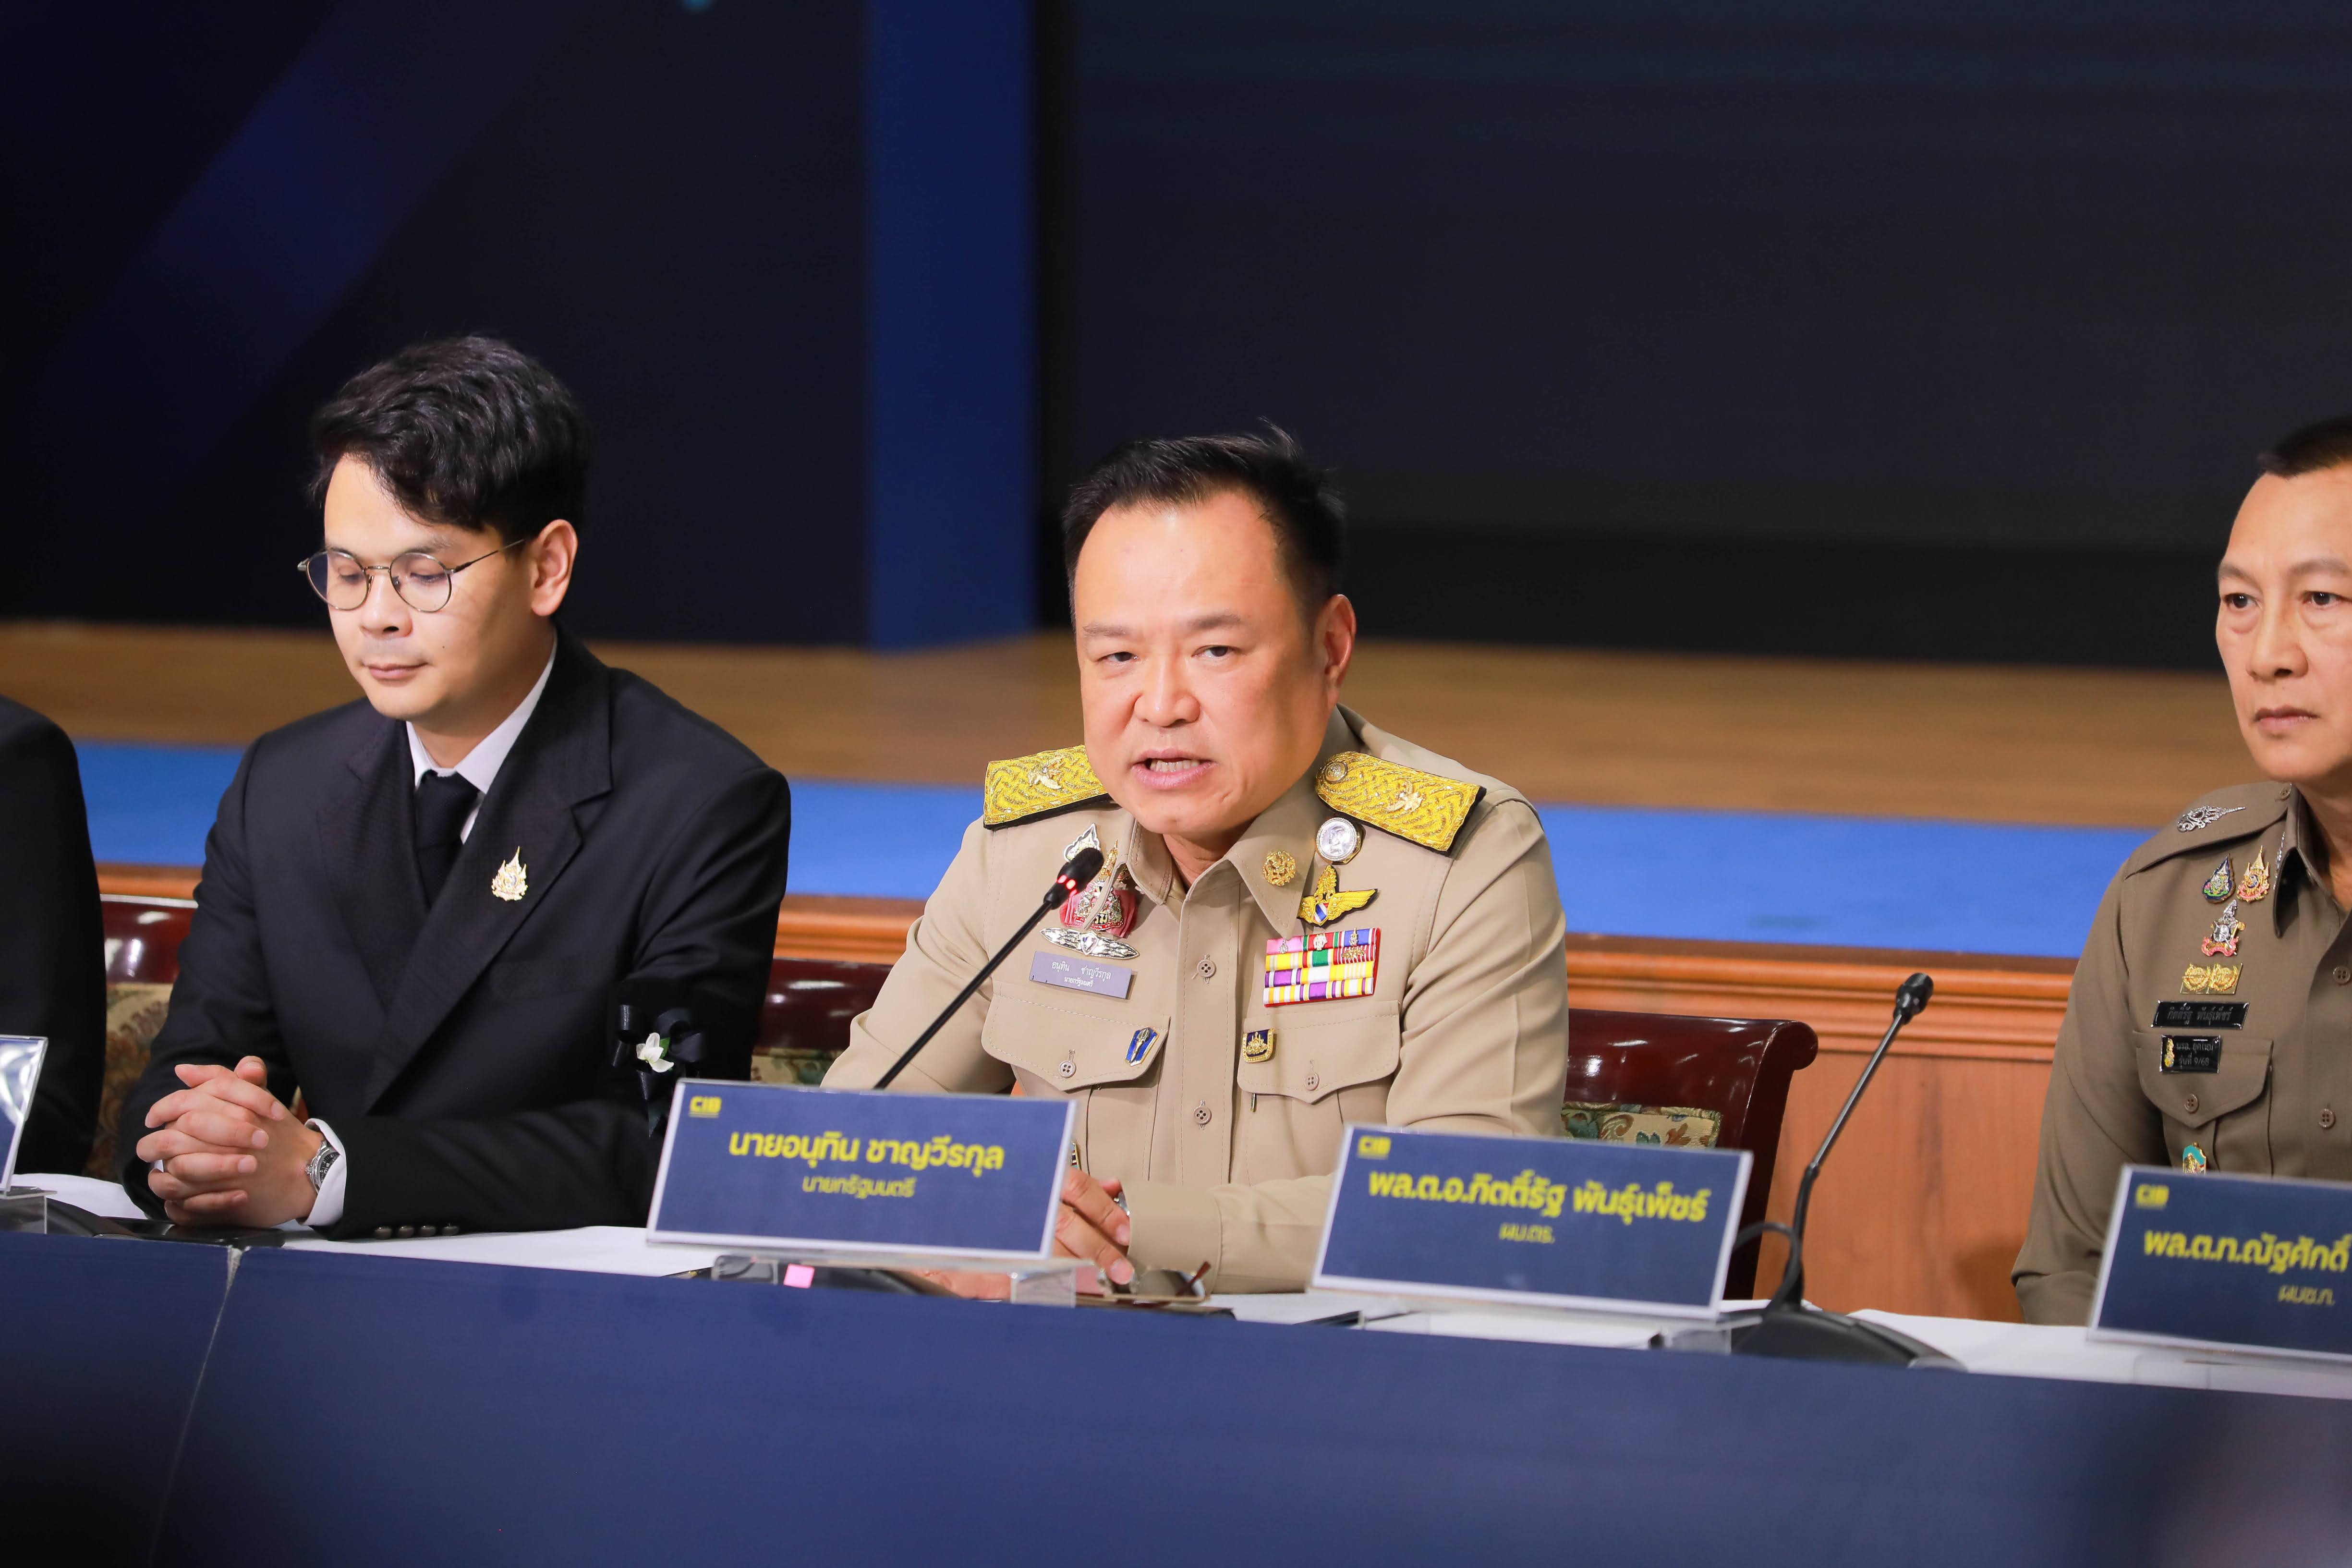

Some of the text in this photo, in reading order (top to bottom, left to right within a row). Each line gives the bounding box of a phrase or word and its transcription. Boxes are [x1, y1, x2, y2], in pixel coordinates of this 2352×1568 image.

[729, 1131, 861, 1168] นายอนุทิน
[802, 1173, 918, 1199] นายกรัฐมนตรี
